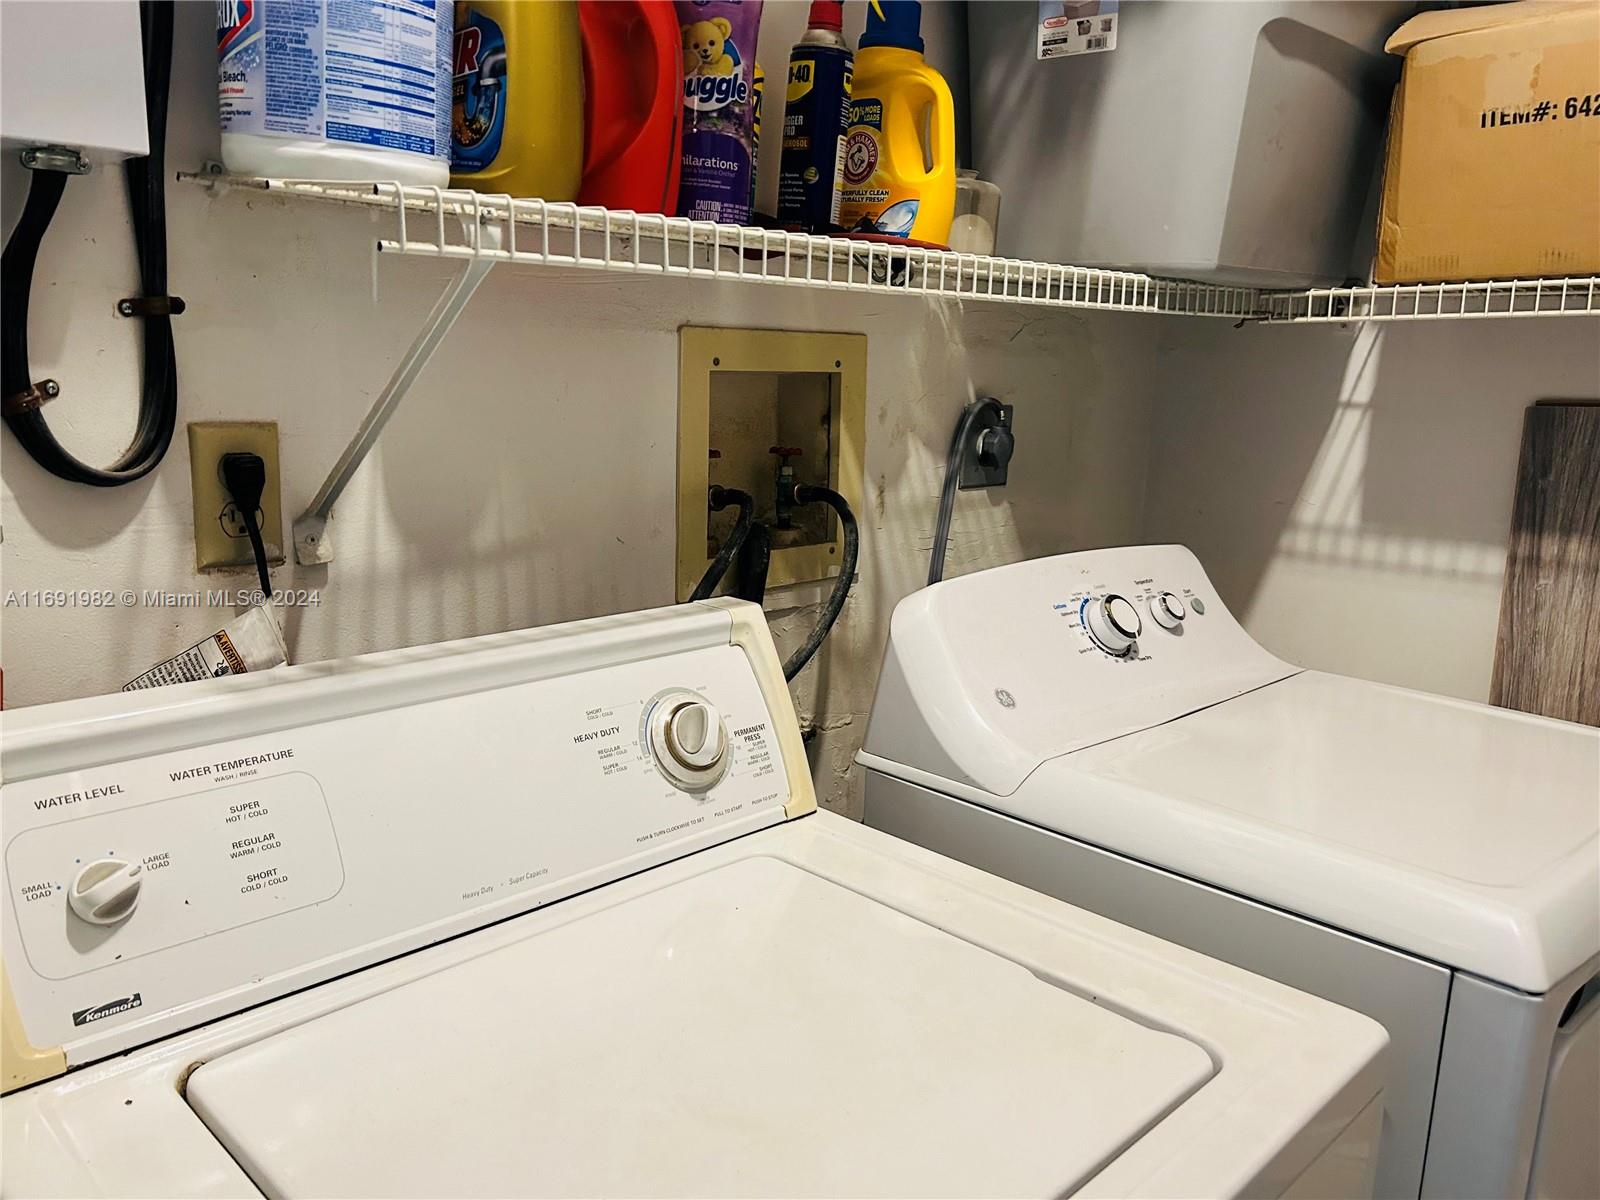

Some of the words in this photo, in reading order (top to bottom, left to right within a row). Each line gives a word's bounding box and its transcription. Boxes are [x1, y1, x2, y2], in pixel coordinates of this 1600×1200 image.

[684, 73, 748, 104] uggle
[864, 106, 880, 114] MORE
[586, 708, 602, 716] SHORT
[574, 732, 598, 744] HEAVY
[600, 726, 620, 738] DUTY
[734, 724, 766, 737] PERMANENT
[744, 732, 760, 742] PRESS
[598, 745, 621, 755] REGULAR
[170, 766, 212, 782] WATER
[213, 748, 294, 772] TEMPERATURE
[602, 762, 619, 770] SUPER
[214, 774, 234, 782] WASH
[240, 768, 258, 777] RINSE
[34, 793, 82, 810] WATER
[84, 784, 125, 800] LEVEL
[230, 800, 260, 814] SUPER
[731, 804, 743, 812] START
[226, 814, 242, 824] HOT
[248, 808, 268, 818] COLD
[666, 821, 690, 834] CLOCKWISE
[232, 832, 276, 850] REGULAR
[230, 848, 255, 860] WARM
[262, 841, 282, 852] COLD
[142, 852, 170, 865] LARGE
[146, 860, 170, 872] LOAD
[246, 868, 278, 883] SHORT
[22, 882, 53, 895] SMALL
[240, 882, 262, 894] COLD
[268, 876, 288, 886] COLD
[462, 890, 480, 900] Heavy
[480, 886, 494, 894] Duty
[508, 875, 525, 886] Super
[526, 868, 548, 880] Capacity
[26, 889, 52, 902] LOAD
[86, 1000, 141, 1022] Kenmore
